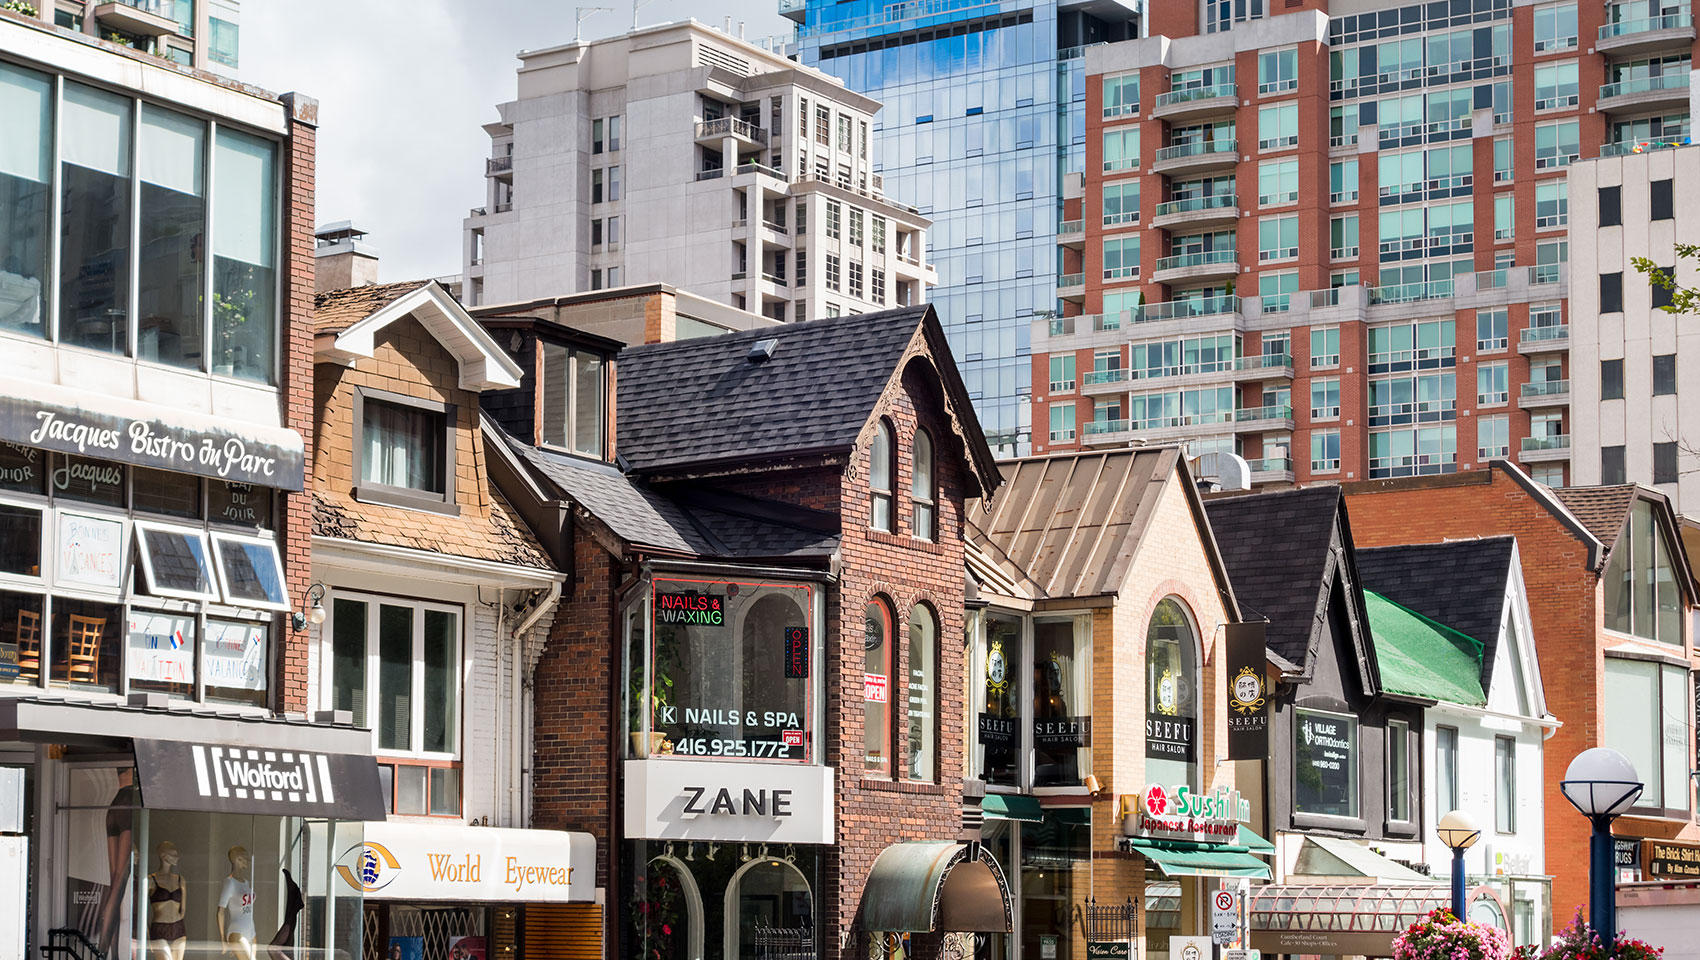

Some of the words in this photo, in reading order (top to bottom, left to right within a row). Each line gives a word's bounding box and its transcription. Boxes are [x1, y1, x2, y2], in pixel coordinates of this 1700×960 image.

[30, 410, 121, 453] Jacques
[128, 420, 195, 462] Bistro
[217, 438, 276, 477] Parc
[232, 492, 247, 505] DU
[222, 505, 256, 520] JOUR
[662, 595, 708, 610] NAILS
[711, 599, 720, 610] &
[662, 610, 722, 625] WAXING
[792, 630, 802, 675] OPEN
[865, 684, 885, 700] OPEN
[662, 707, 675, 723] K
[685, 708, 740, 726] NAILS
[746, 711, 758, 727] &
[763, 712, 800, 728] SPA
[1228, 716, 1267, 726] SEEFU
[980, 718, 1013, 733] SEEFU
[1035, 721, 1090, 735] SEEFU
[1146, 719, 1191, 741] SEEFU
[1314, 722, 1337, 736] VILLAGE
[785, 736, 800, 744] OPEN
[676, 738, 790, 758] 416.925.1772
[1151, 743, 1165, 752] HAIR
[1166, 744, 1186, 754] SALON
[224, 760, 303, 790] Wolford
[683, 787, 792, 816] ZANE
[1177, 786, 1230, 818] Sushi
[1139, 815, 1185, 834] Japanese
[1187, 819, 1238, 836] Restaurant
[1654, 845, 1666, 859] The
[1666, 846, 1681, 861] Brick
[1681, 848, 1695, 862] Shirt
[427, 853, 481, 882] World
[504, 856, 574, 892] Eyewear
[1667, 863, 1673, 874] By
[1088, 945, 1109, 955] Vision
